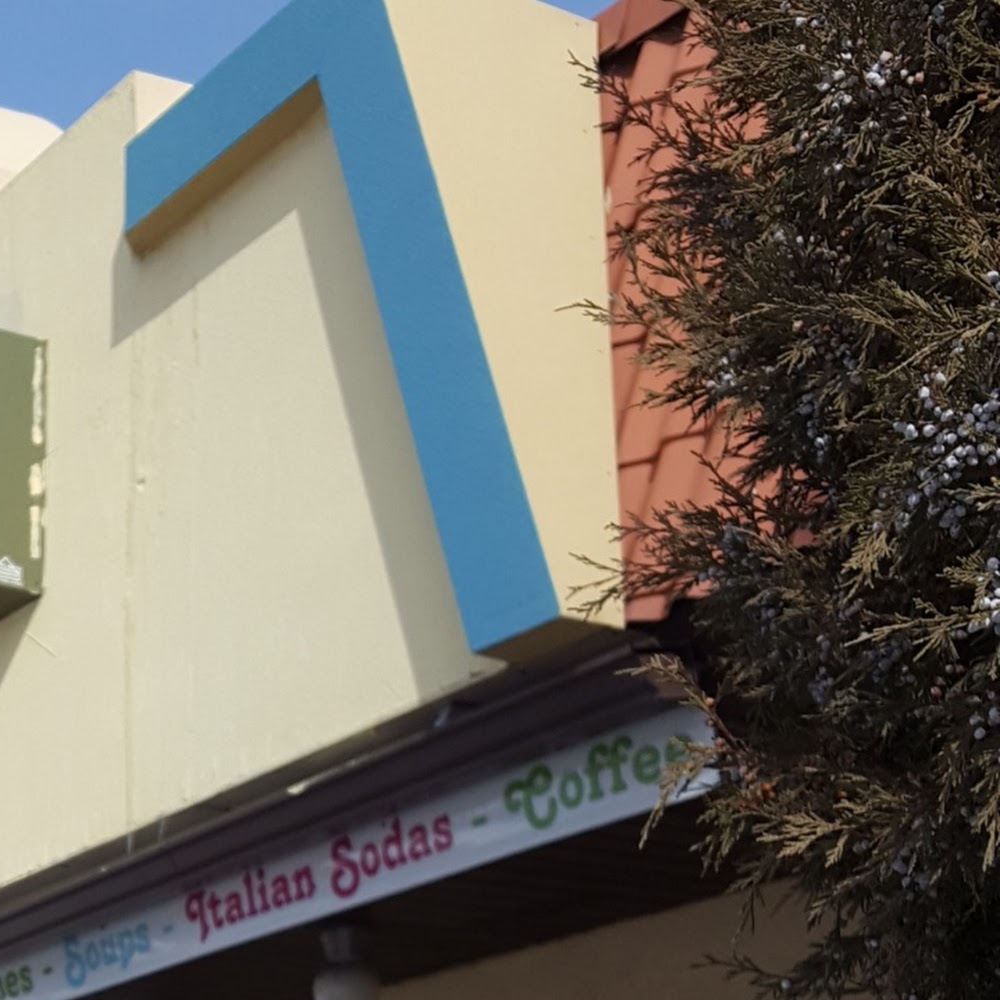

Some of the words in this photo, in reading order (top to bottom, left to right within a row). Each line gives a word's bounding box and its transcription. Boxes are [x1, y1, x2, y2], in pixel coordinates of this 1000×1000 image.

[62, 923, 151, 986] Soups
[185, 862, 315, 942] Italian
[330, 813, 453, 896] Sodas
